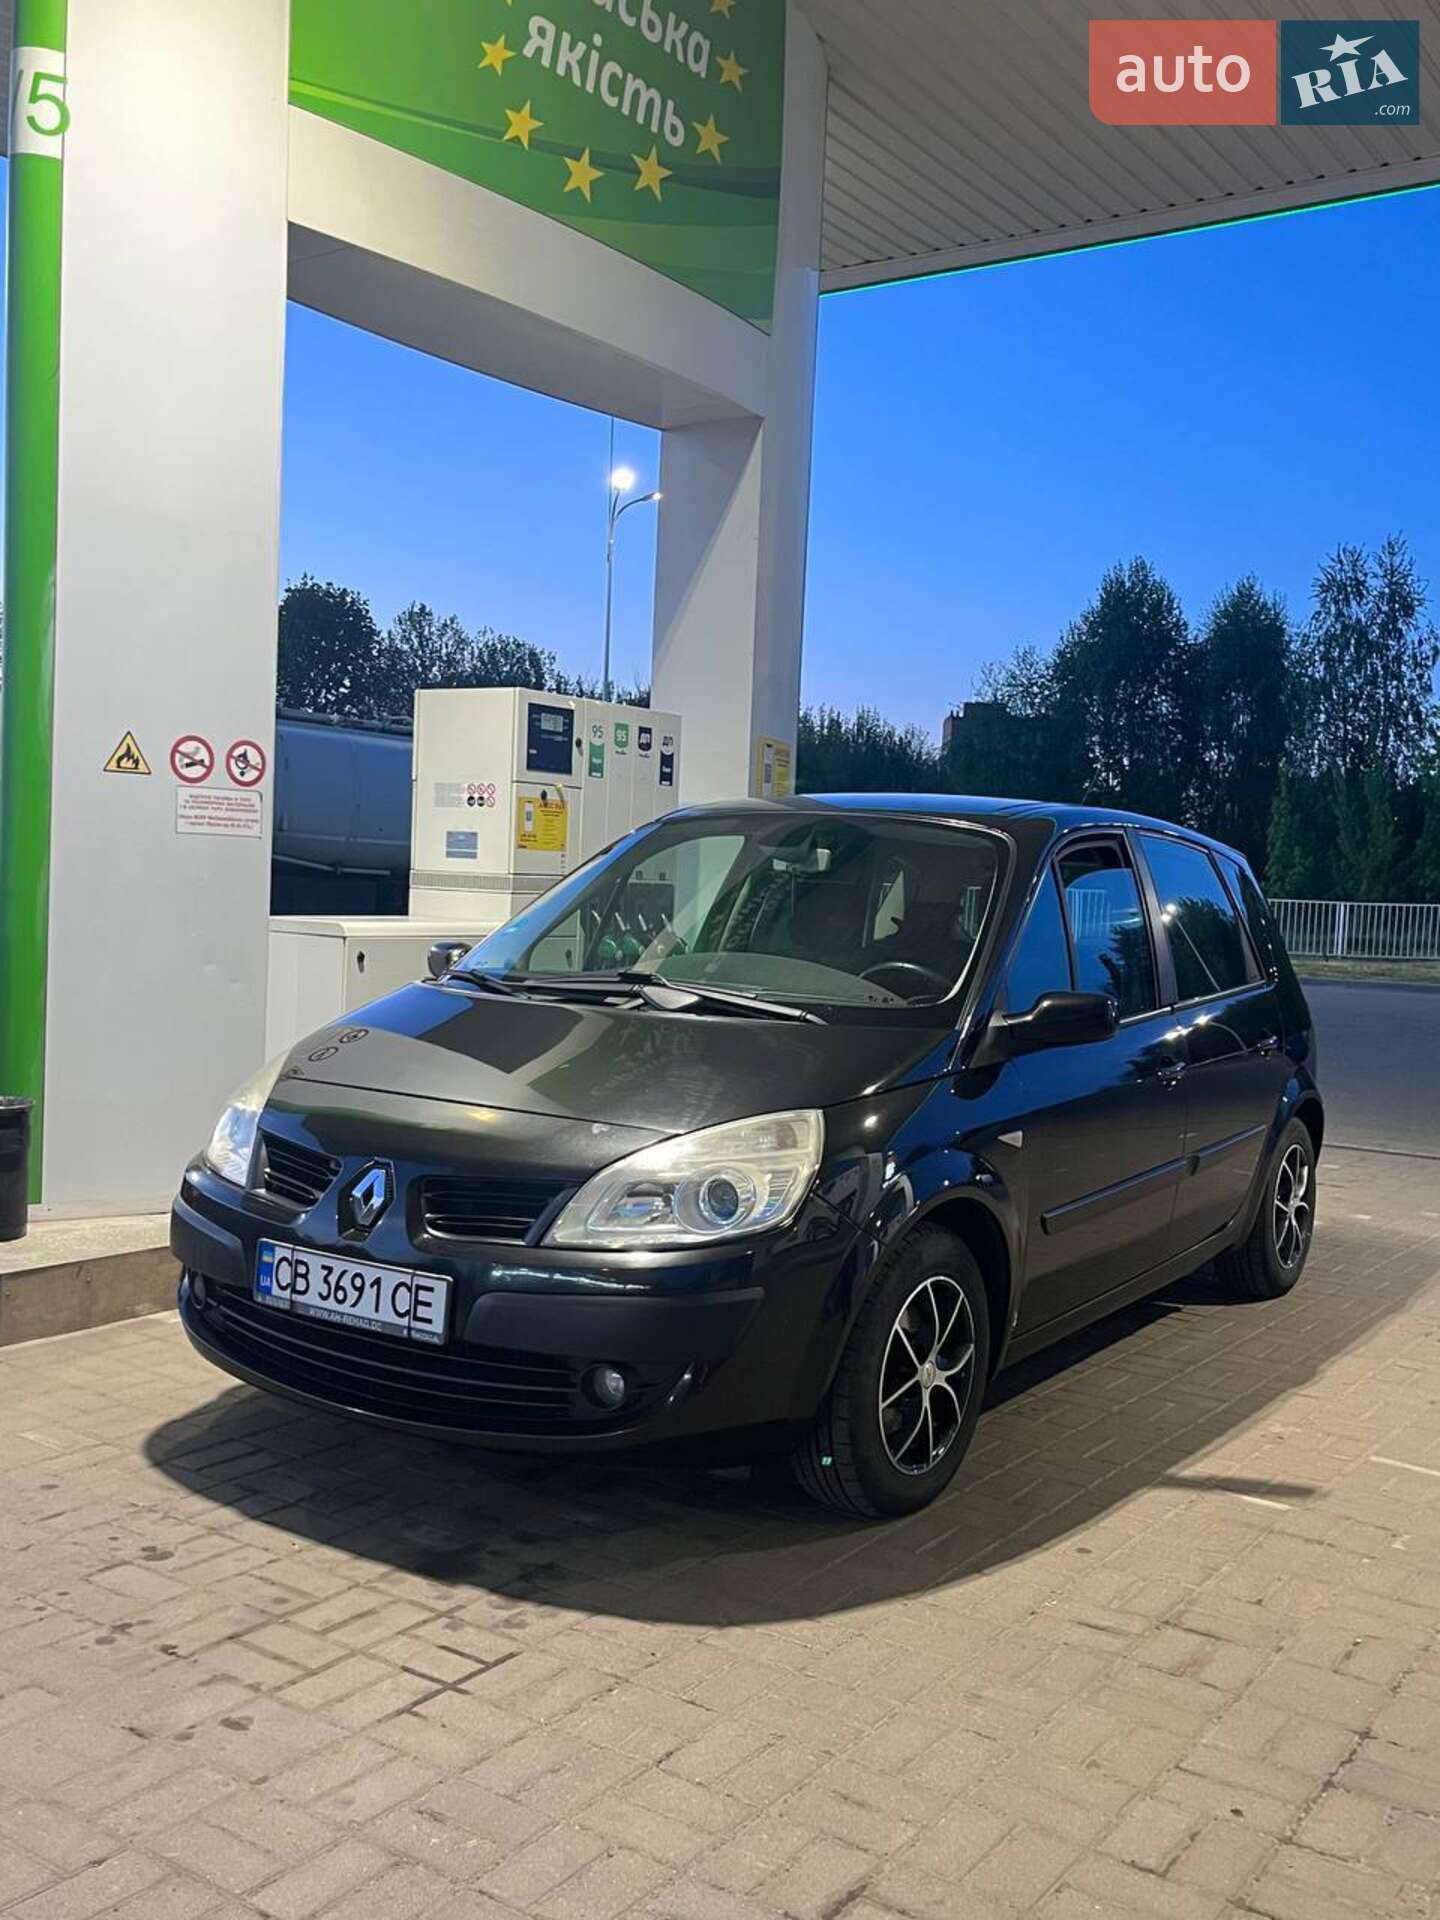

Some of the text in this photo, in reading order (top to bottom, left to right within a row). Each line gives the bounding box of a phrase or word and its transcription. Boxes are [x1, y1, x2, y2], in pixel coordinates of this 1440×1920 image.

[522, 15, 685, 147] якість
[592, 724, 603, 739] 95
[259, 1273, 271, 1287] UA
[275, 1256, 434, 1325] CB 3691 CE
